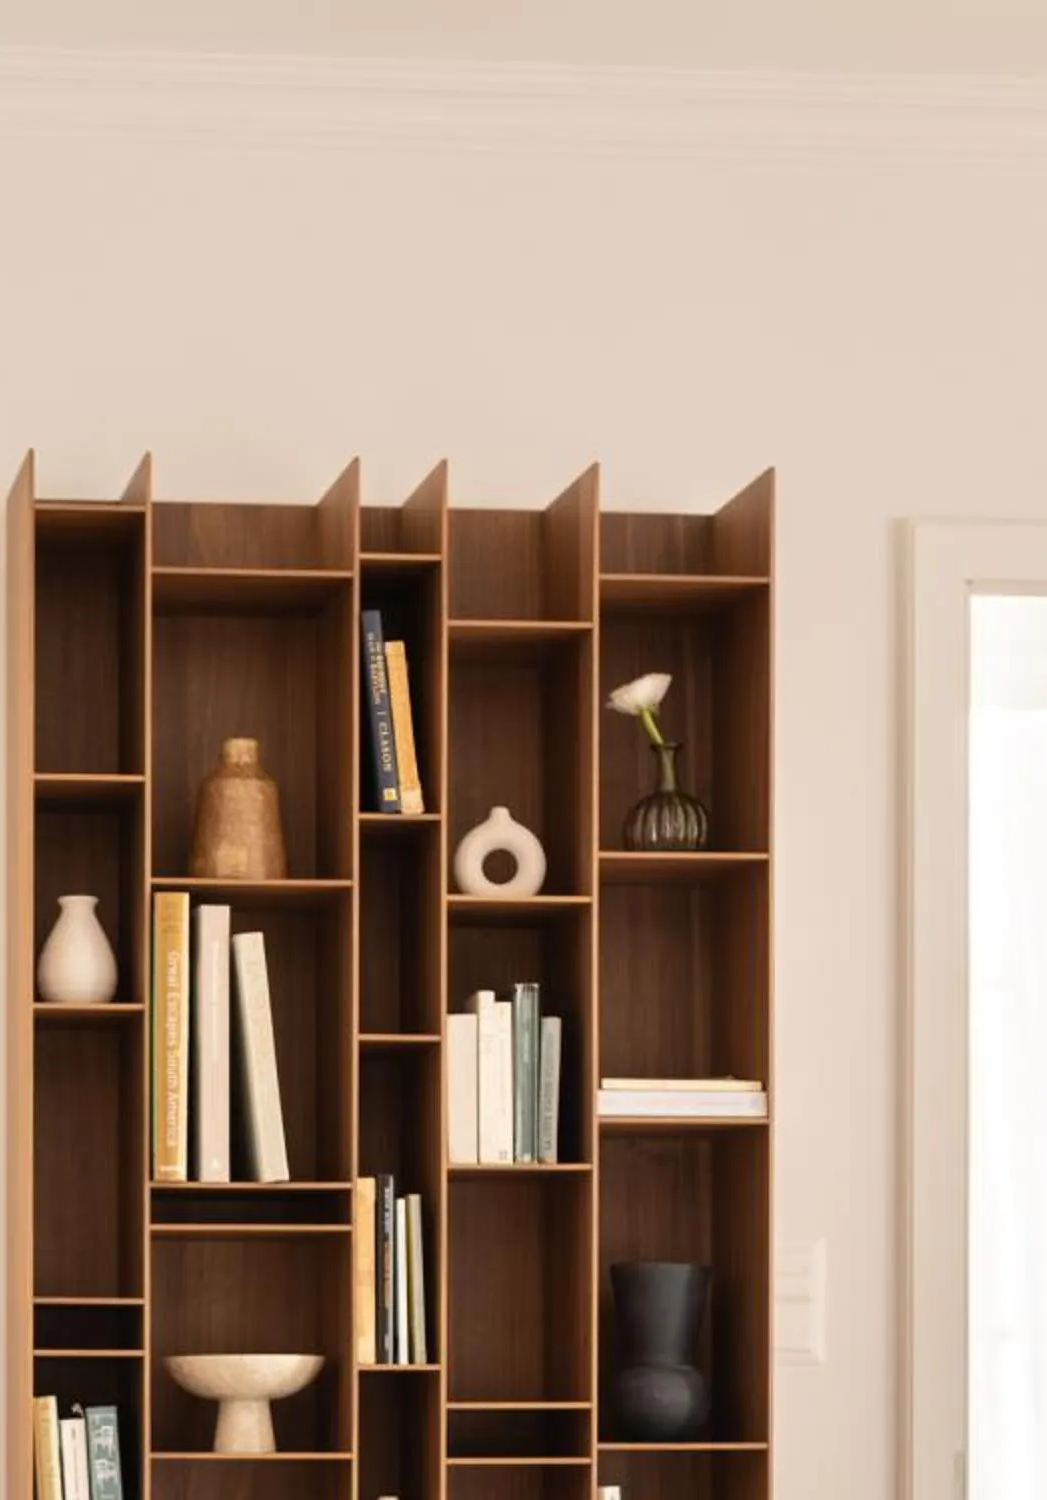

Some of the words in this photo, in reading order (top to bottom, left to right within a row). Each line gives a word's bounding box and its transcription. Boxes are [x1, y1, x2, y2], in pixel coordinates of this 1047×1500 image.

[165, 950, 180, 987] Great
[165, 991, 180, 1047] Escapes
[165, 1050, 180, 1088] South
[165, 1091, 180, 1147] America
